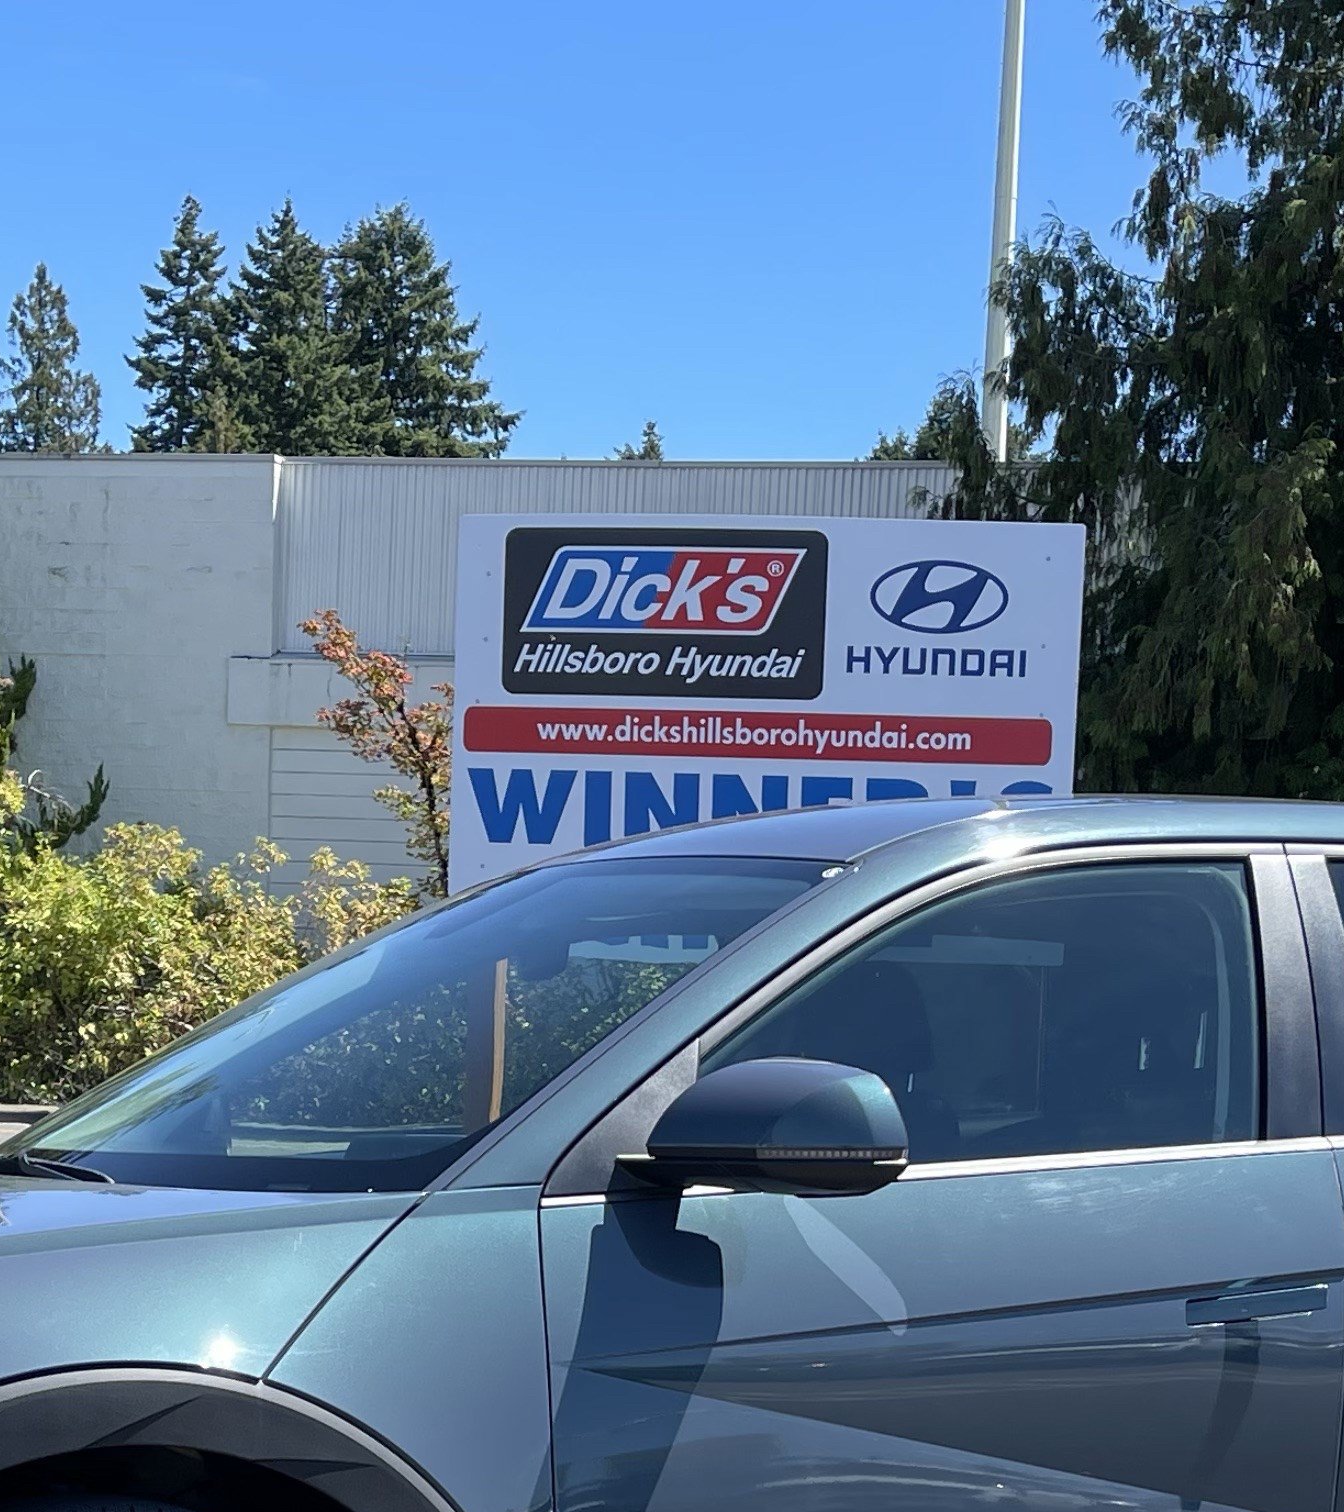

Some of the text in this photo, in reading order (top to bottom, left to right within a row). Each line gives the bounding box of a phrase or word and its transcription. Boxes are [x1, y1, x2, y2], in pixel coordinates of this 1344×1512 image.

[542, 556, 769, 624] Dick's
[513, 643, 806, 684] Hillsboro Hyundai
[845, 645, 1027, 678] HYUNDAI
[536, 715, 972, 754] www.dickshillsborohyundai.com
[467, 767, 1053, 848] WINN'
